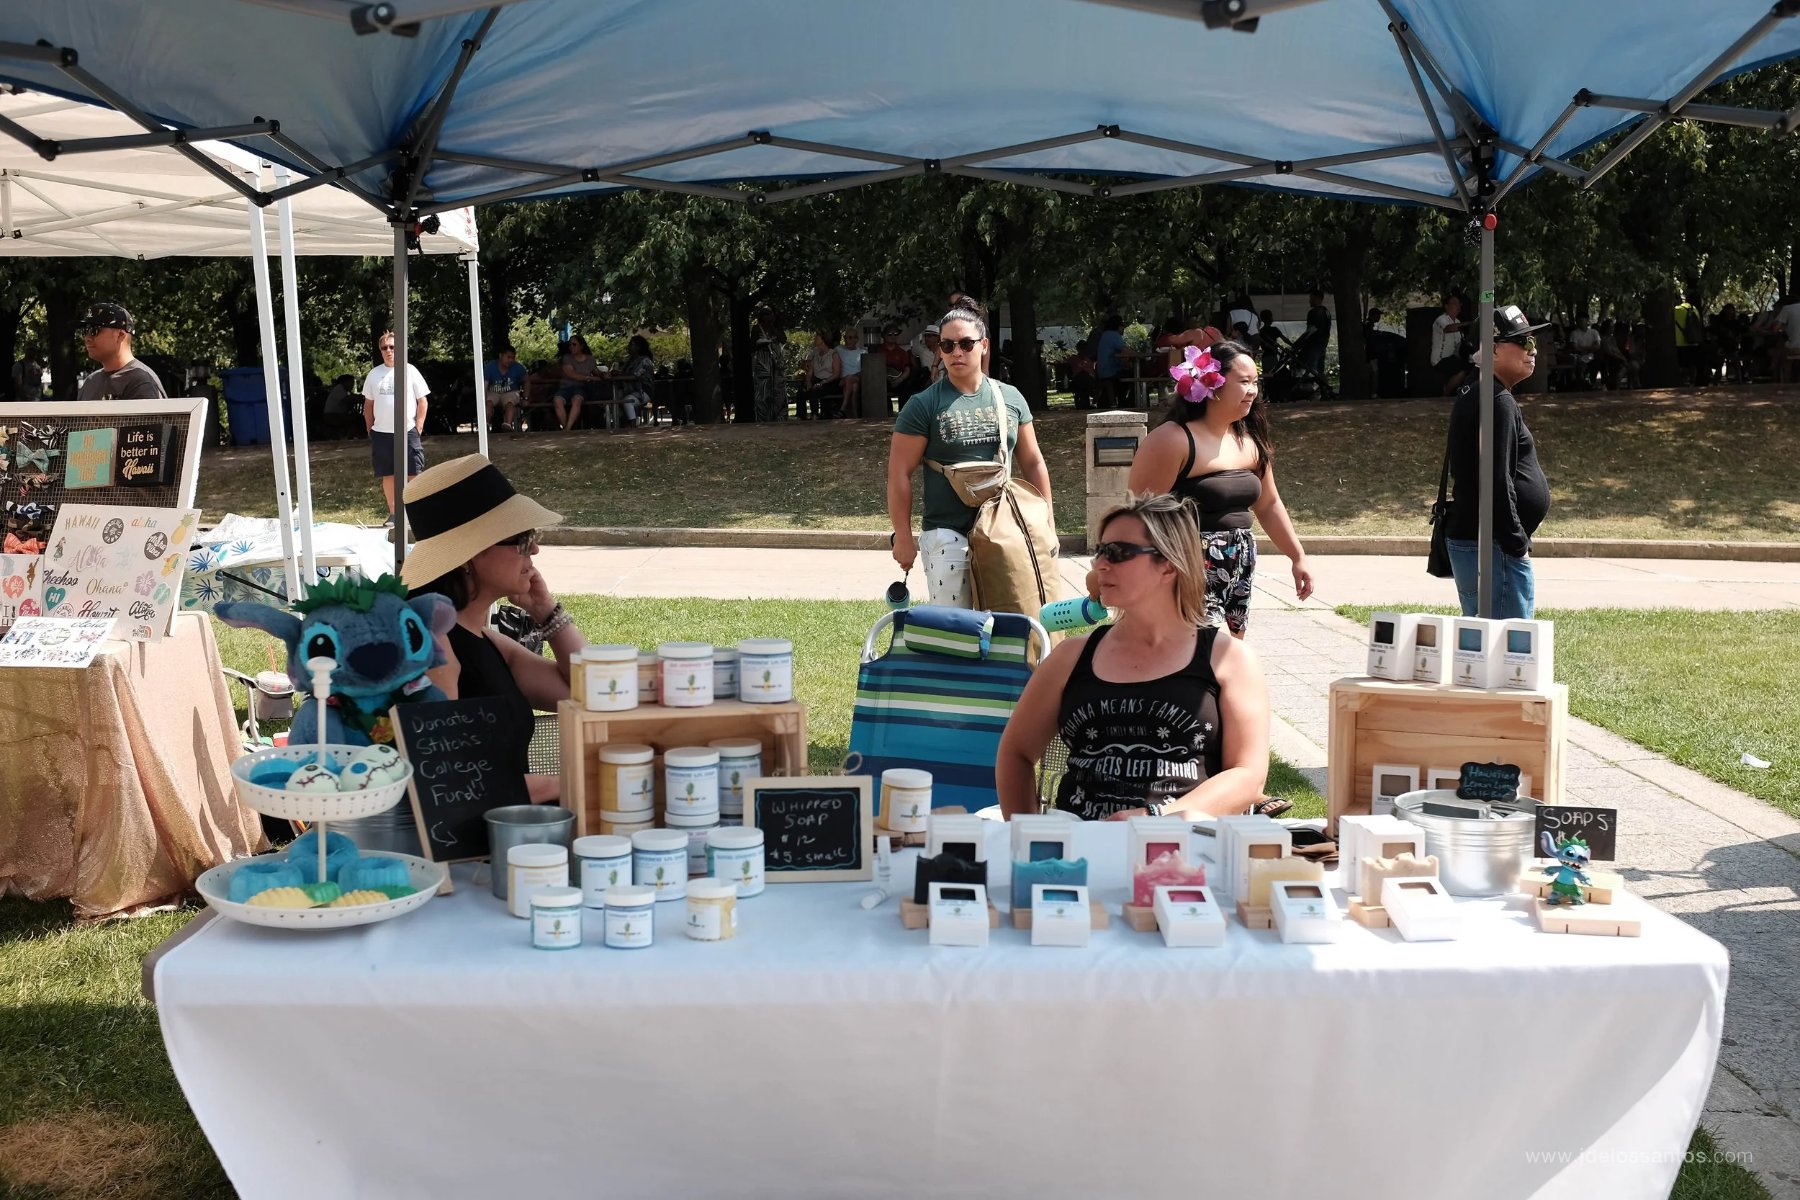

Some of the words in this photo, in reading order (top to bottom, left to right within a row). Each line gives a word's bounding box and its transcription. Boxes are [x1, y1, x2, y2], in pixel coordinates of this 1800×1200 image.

[127, 431, 144, 443] Life
[146, 430, 154, 442] is
[120, 446, 147, 458] better
[150, 444, 159, 456] in
[122, 458, 154, 480] Hawaii
[65, 515, 101, 530] HAWAII
[86, 578, 124, 595] Ohana
[48, 592, 60, 602] HI
[411, 711, 474, 733] Donate
[478, 707, 497, 723] to
[1064, 702, 1096, 738] OHANA
[1100, 698, 1144, 716] MEANS
[1148, 700, 1200, 733] FAMILY
[420, 758, 493, 782] College
[1095, 756, 1123, 777] GETS
[1126, 758, 1153, 778] LEFT
[1156, 757, 1200, 780] BEHIND
[771, 799, 842, 814] WHIPPED
[784, 813, 829, 829] SOAP
[1543, 808, 1609, 831] SOAPS
